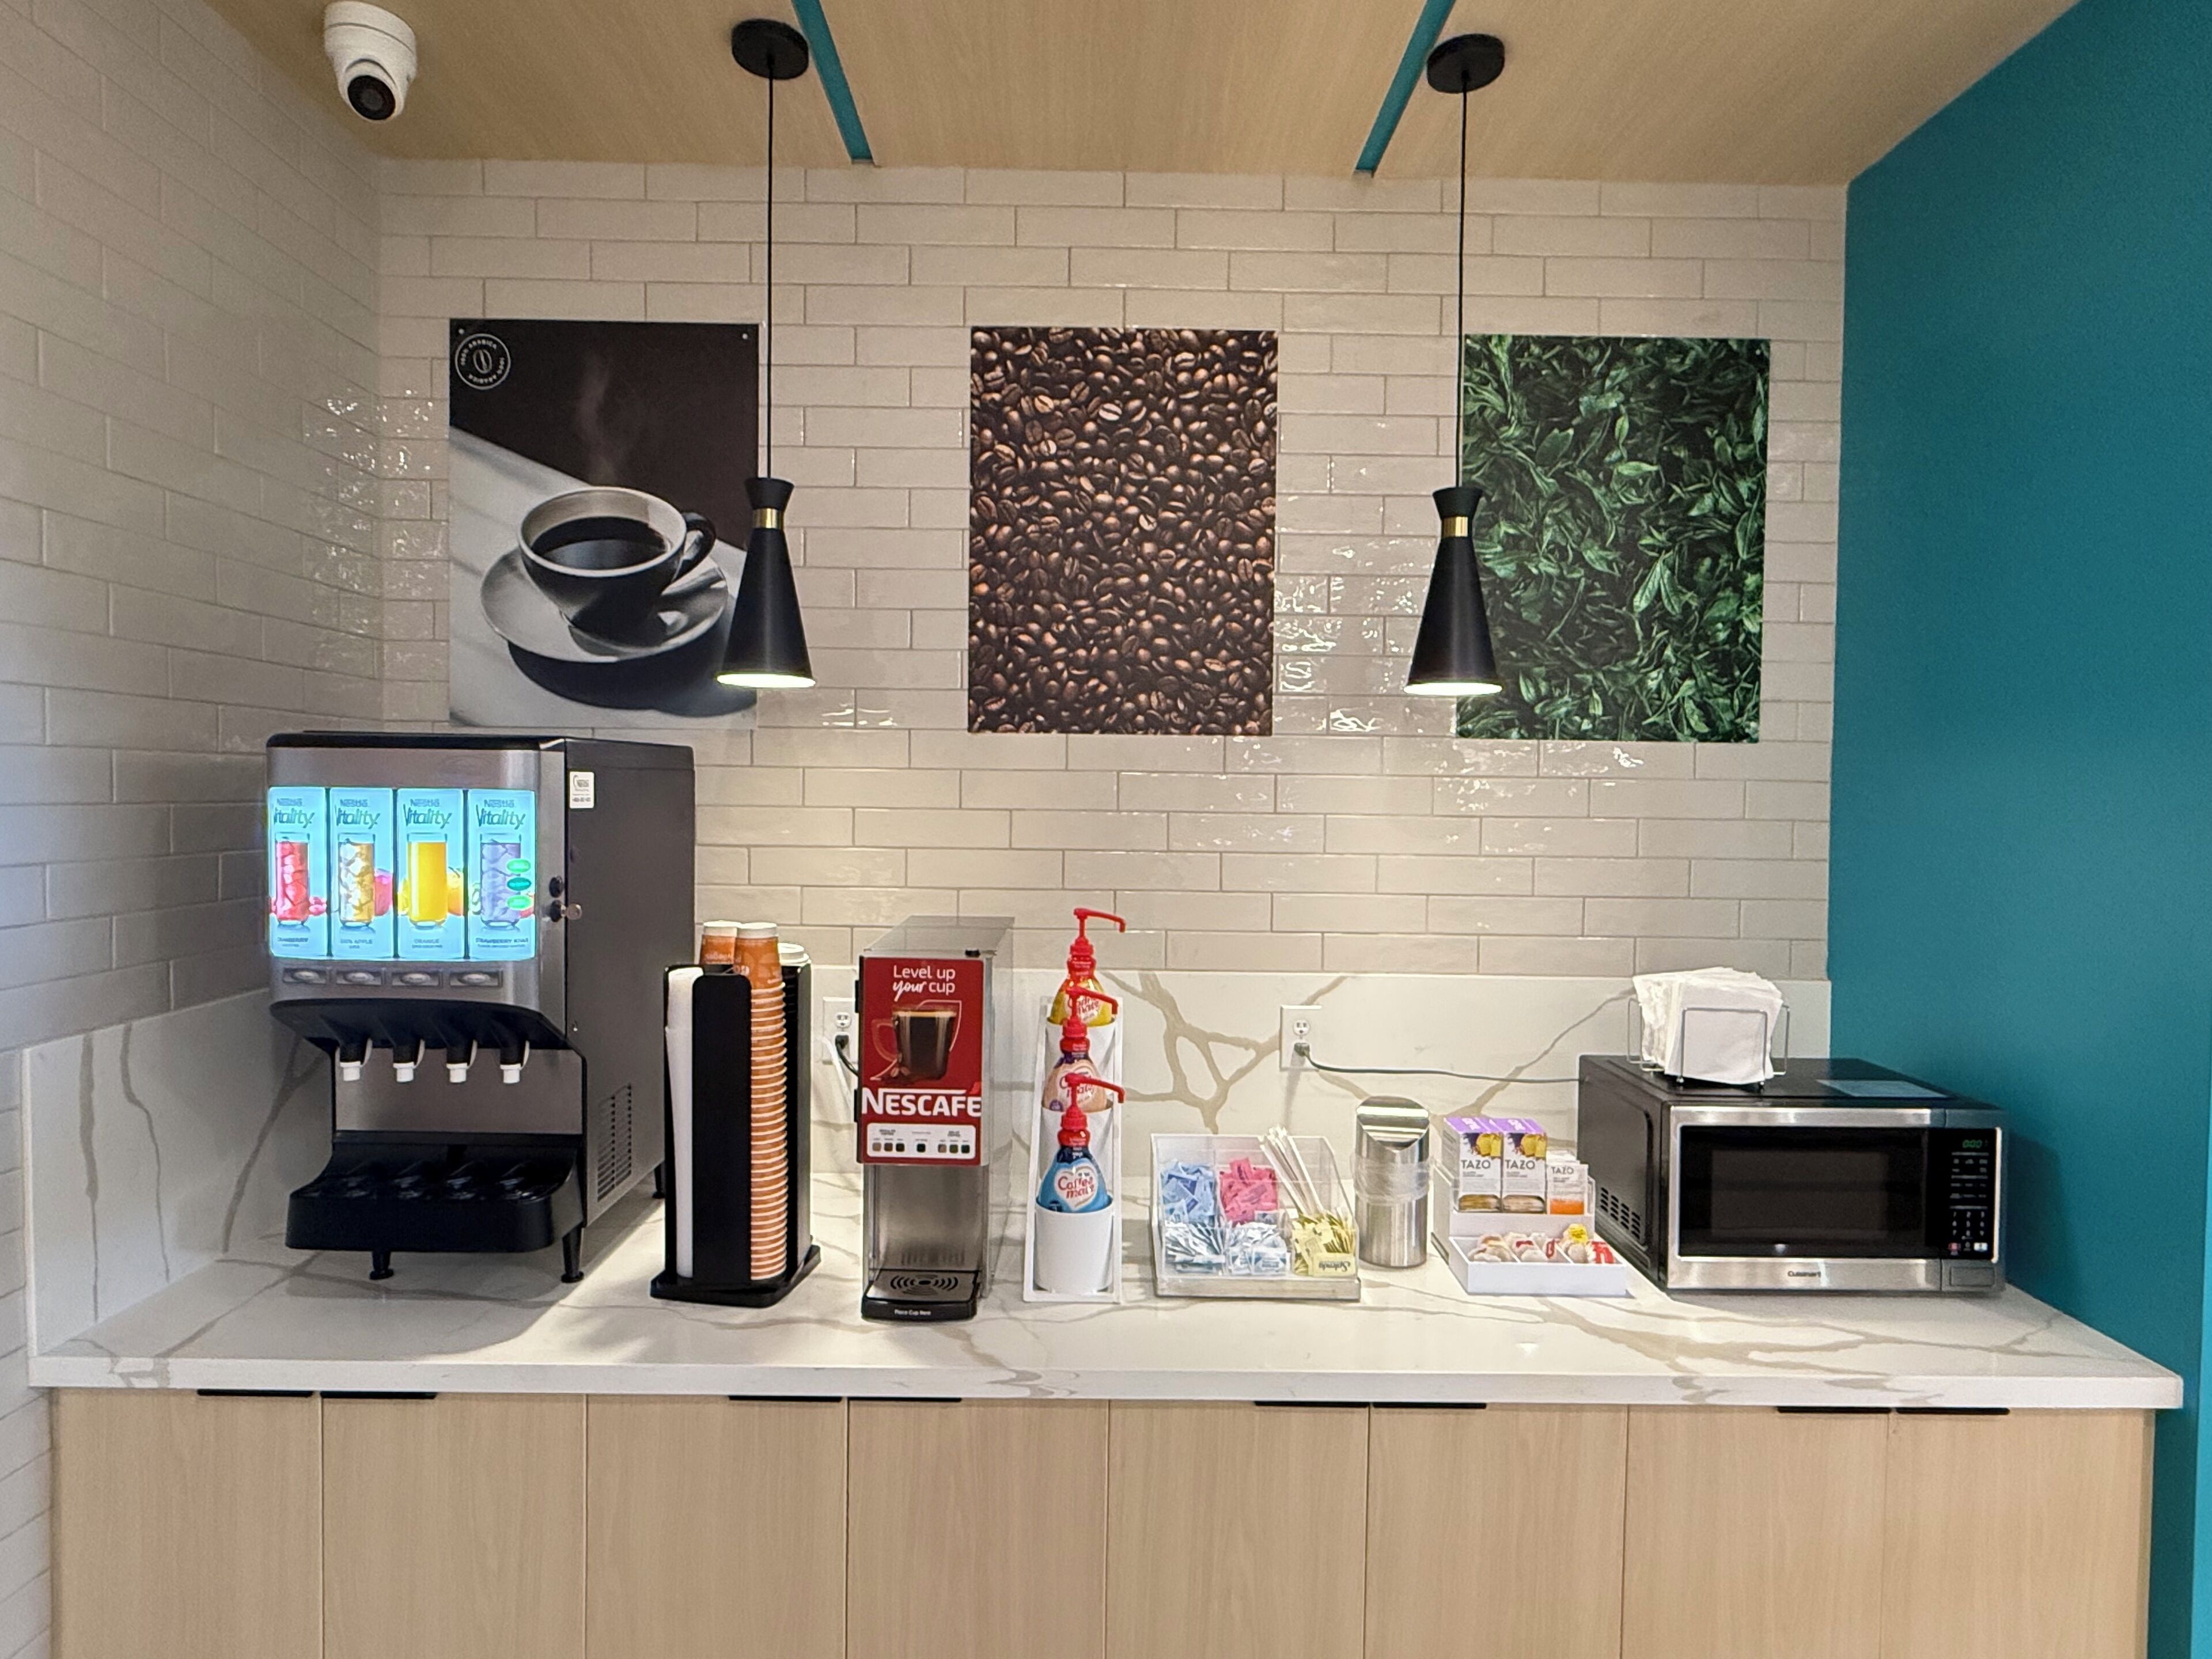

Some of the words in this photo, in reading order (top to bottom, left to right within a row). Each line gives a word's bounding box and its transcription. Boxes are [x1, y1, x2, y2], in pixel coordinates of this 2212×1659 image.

[335, 805, 380, 830] Vitality
[403, 804, 452, 829] Vitality
[476, 804, 526, 830] Vitality
[893, 965, 932, 979] Level
[937, 968, 956, 980] up
[892, 980, 926, 1002] your
[929, 982, 956, 995] cup
[1461, 1159, 1491, 1169] TAZO
[1505, 1159, 1535, 1170] TAZO
[1551, 1166, 1574, 1175] TAZO
